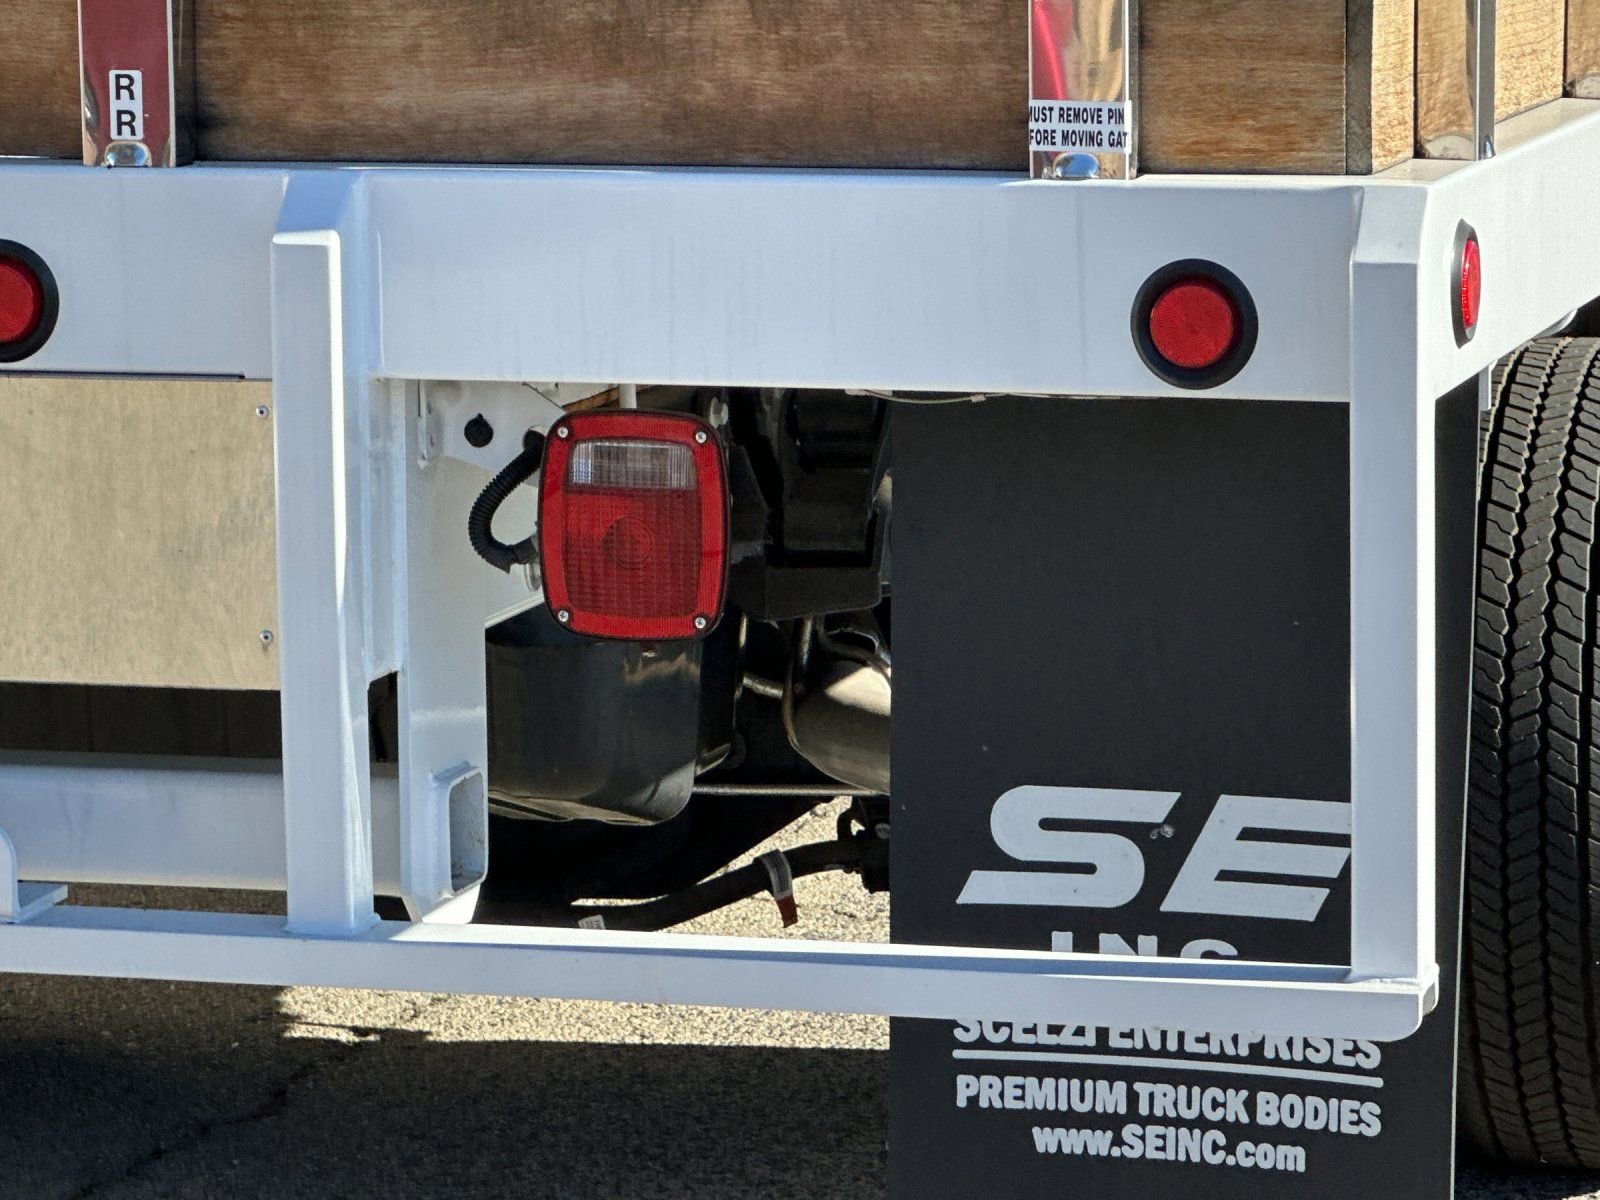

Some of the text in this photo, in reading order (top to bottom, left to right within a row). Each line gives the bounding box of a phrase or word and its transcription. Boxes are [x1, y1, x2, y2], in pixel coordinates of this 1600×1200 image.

[1058, 107, 1103, 124] REMOVE
[1061, 129, 1103, 147] MOVING
[956, 785, 1352, 922] SE
[956, 1074, 1382, 1137] PREMIUM TRUCK BODIES
[1031, 1123, 1306, 1173] www.SEINC.com
